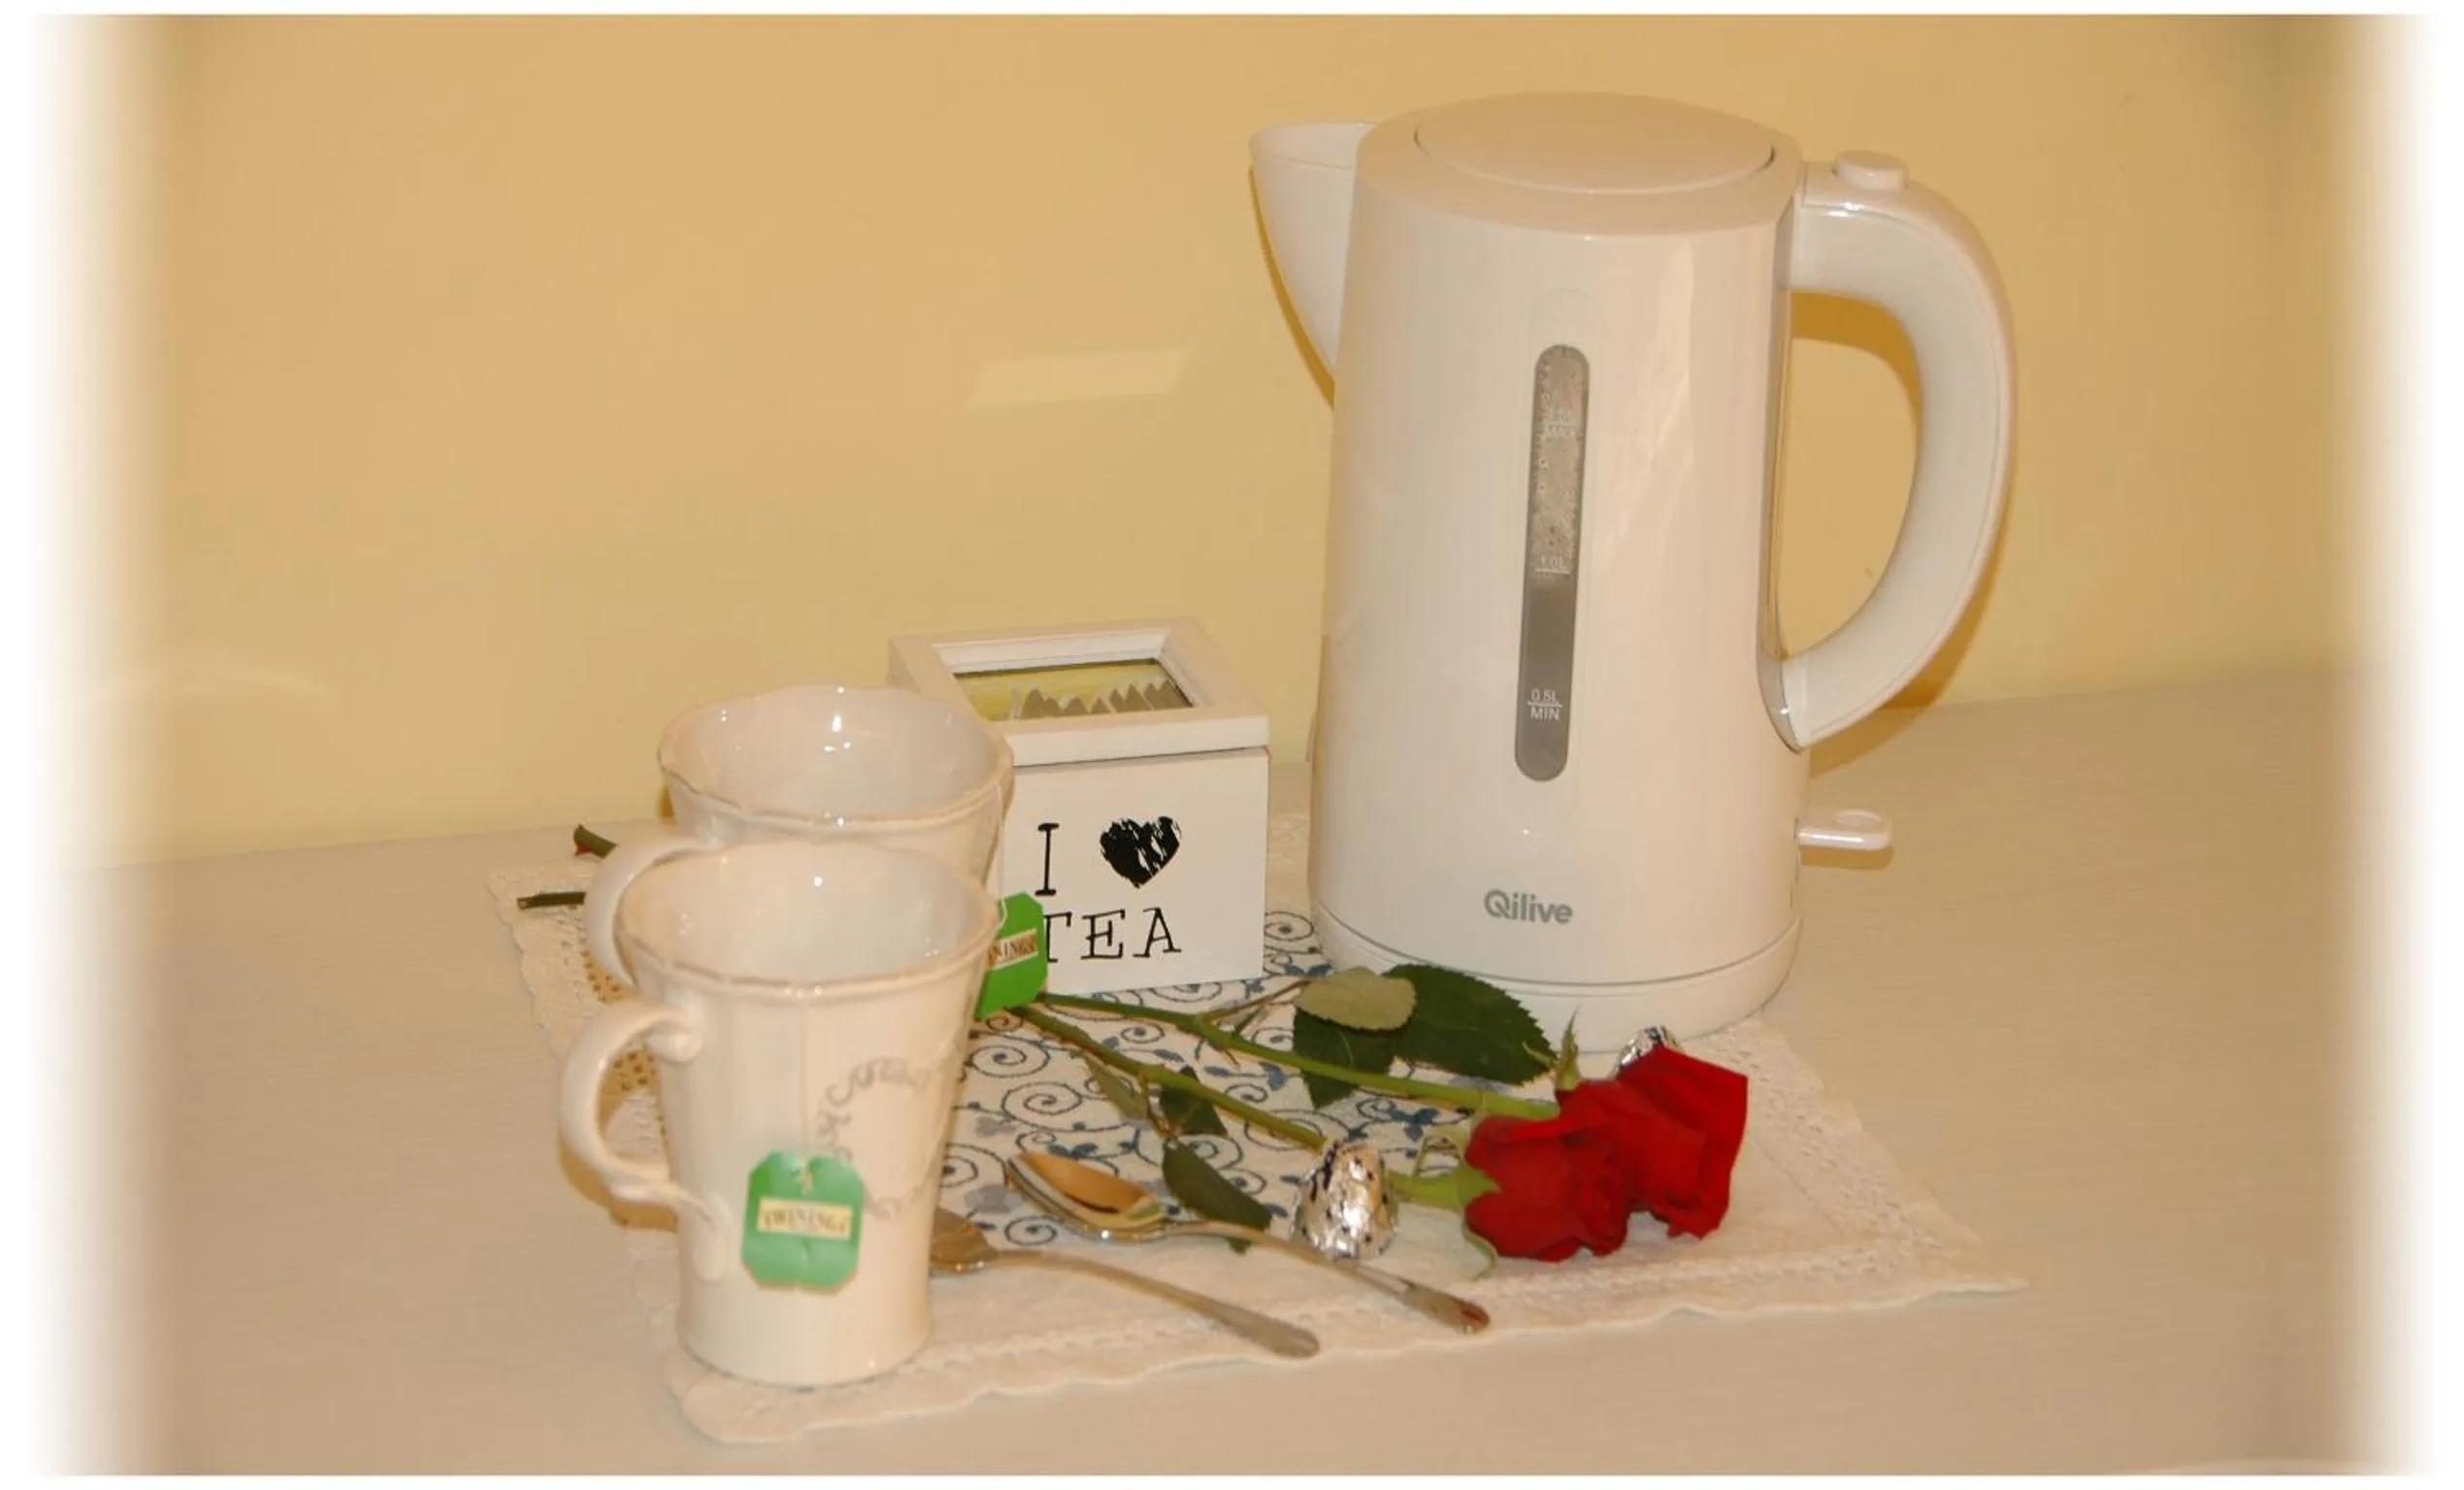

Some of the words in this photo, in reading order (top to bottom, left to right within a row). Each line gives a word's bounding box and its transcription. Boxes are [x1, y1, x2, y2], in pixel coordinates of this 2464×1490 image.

[1529, 706, 1561, 720] MIN
[1035, 822, 1060, 896] I
[1484, 888, 1573, 924] Qilive
[1043, 907, 1182, 963] TEA
